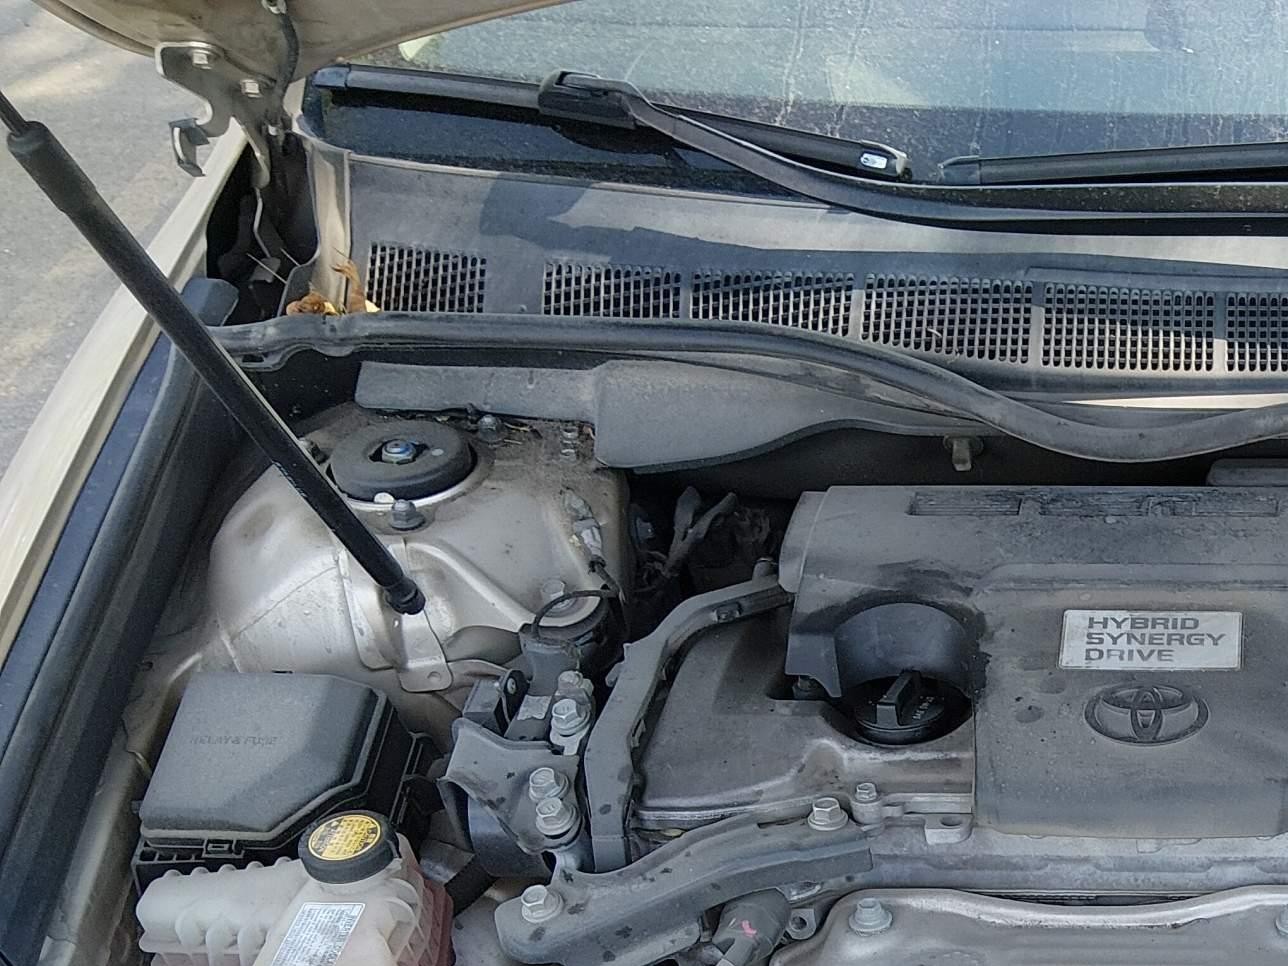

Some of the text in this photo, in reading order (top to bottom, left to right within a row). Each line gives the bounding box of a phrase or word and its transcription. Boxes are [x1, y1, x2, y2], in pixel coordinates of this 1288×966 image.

[1088, 617, 1199, 630] HYBRID
[1086, 632, 1226, 646] SYNERGY
[1084, 648, 1175, 662] DRIVE
